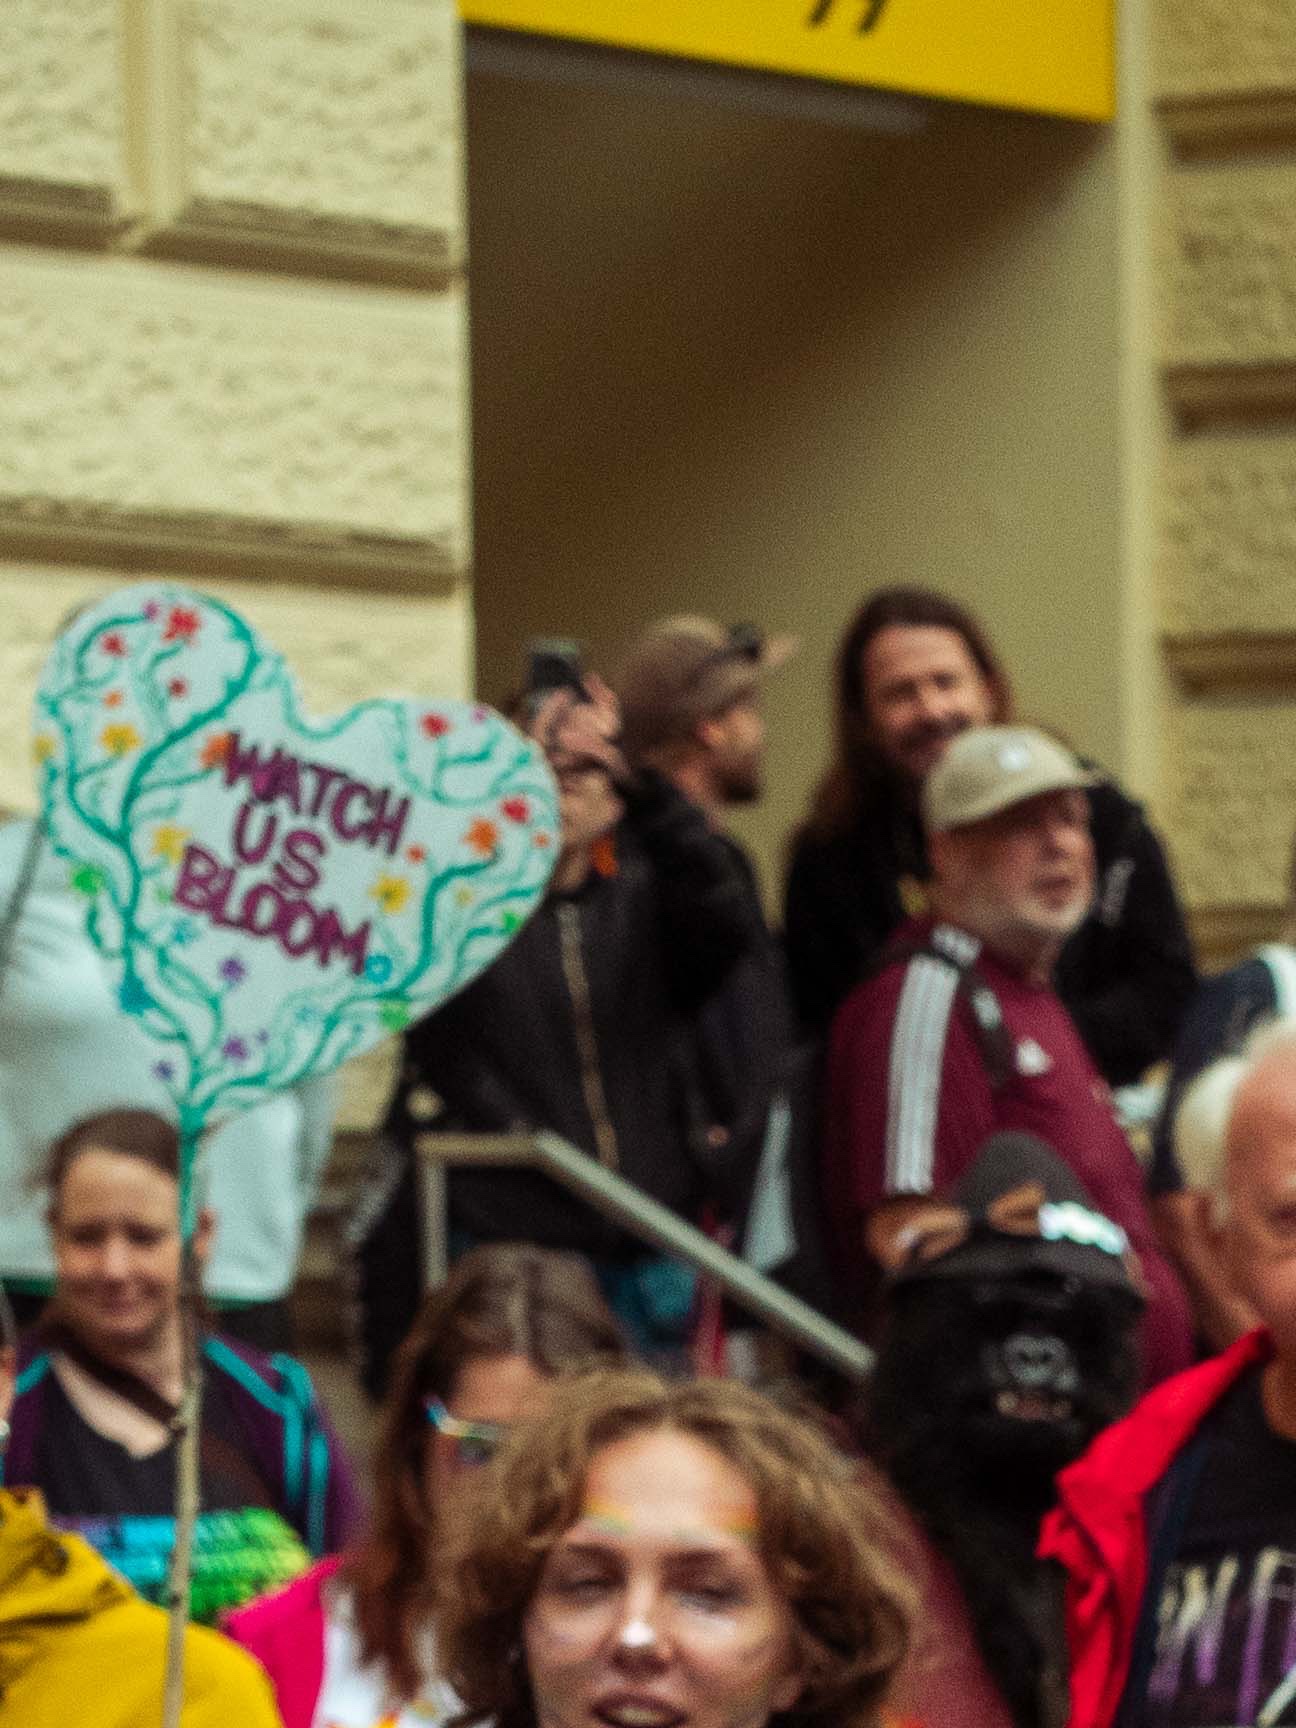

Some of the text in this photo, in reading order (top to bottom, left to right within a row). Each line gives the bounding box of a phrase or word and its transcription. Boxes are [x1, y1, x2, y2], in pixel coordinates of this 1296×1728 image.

[224, 731, 412, 857] WATCH
[233, 801, 326, 892] US
[174, 843, 371, 977] BLOOM
